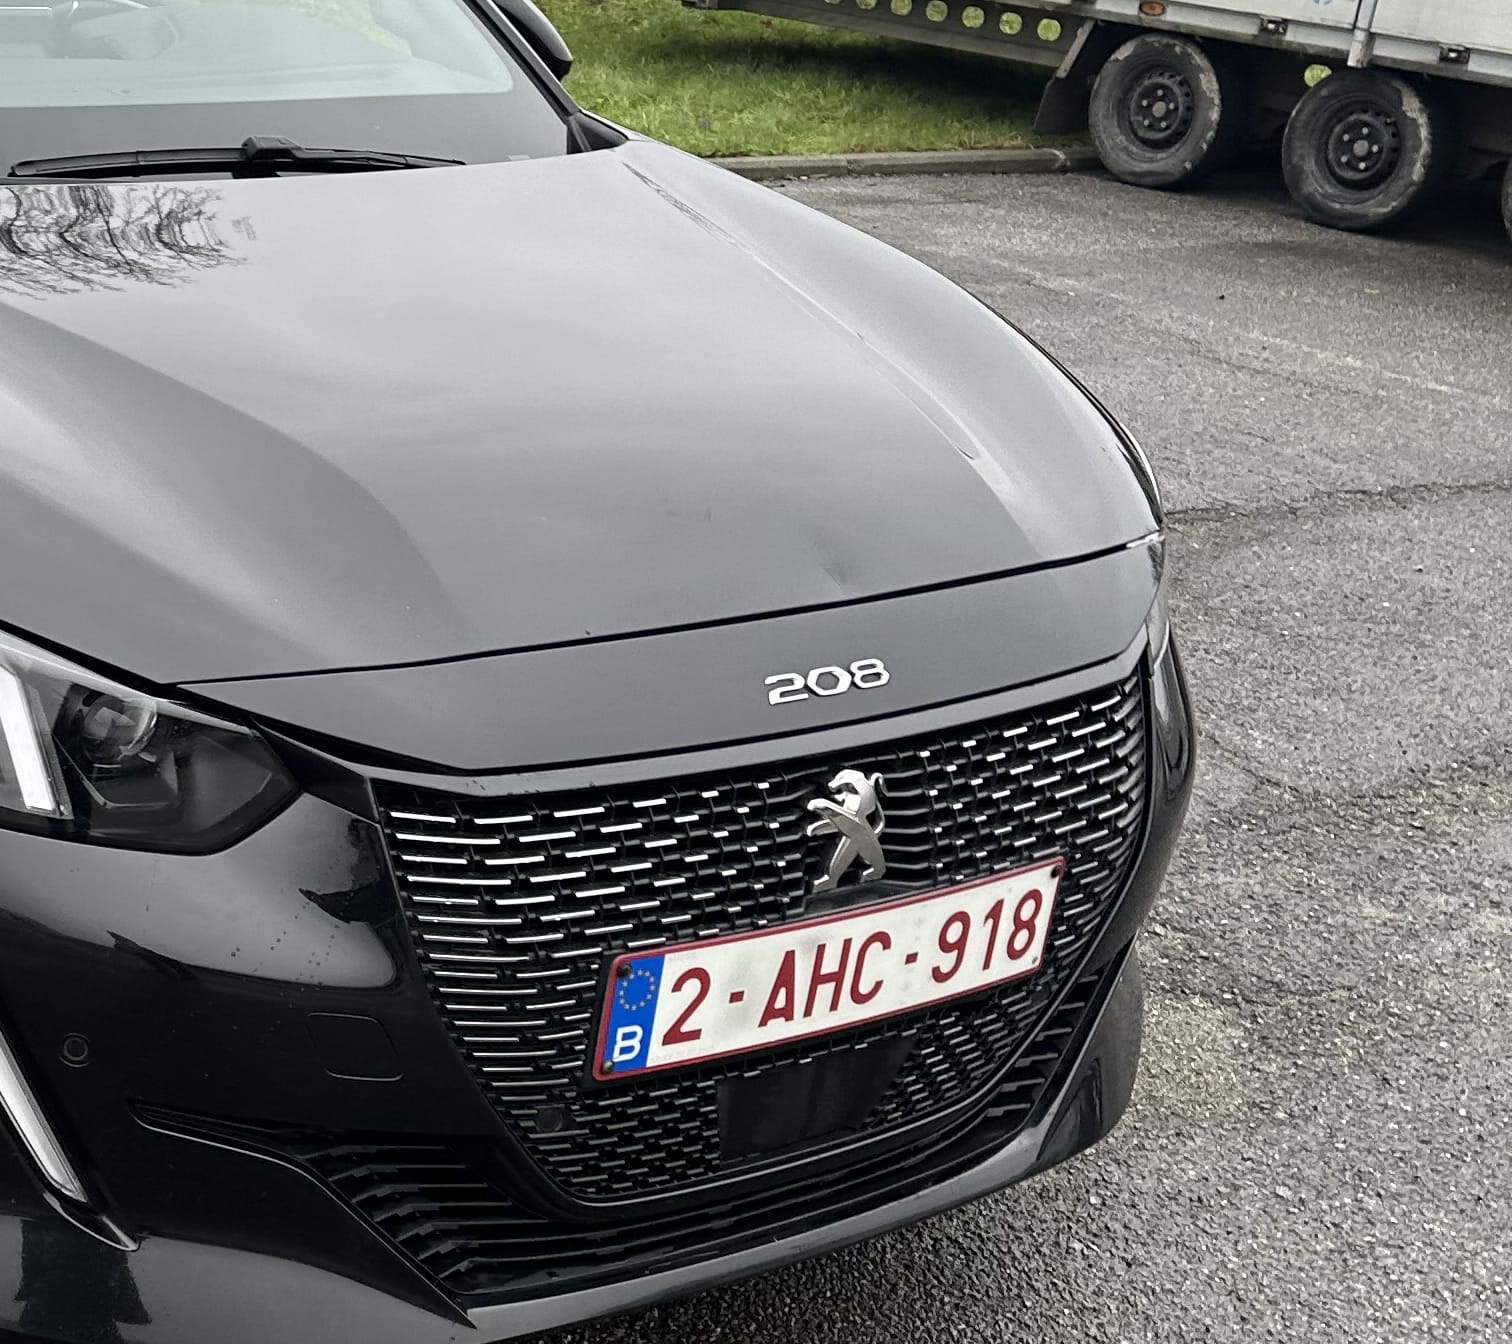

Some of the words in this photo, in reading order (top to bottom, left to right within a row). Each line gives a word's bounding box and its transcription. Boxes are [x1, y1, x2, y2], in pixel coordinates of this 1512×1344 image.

[764, 658, 890, 706] 208
[661, 888, 1044, 1047] 2-AHC-918
[612, 1025, 644, 1063] B
